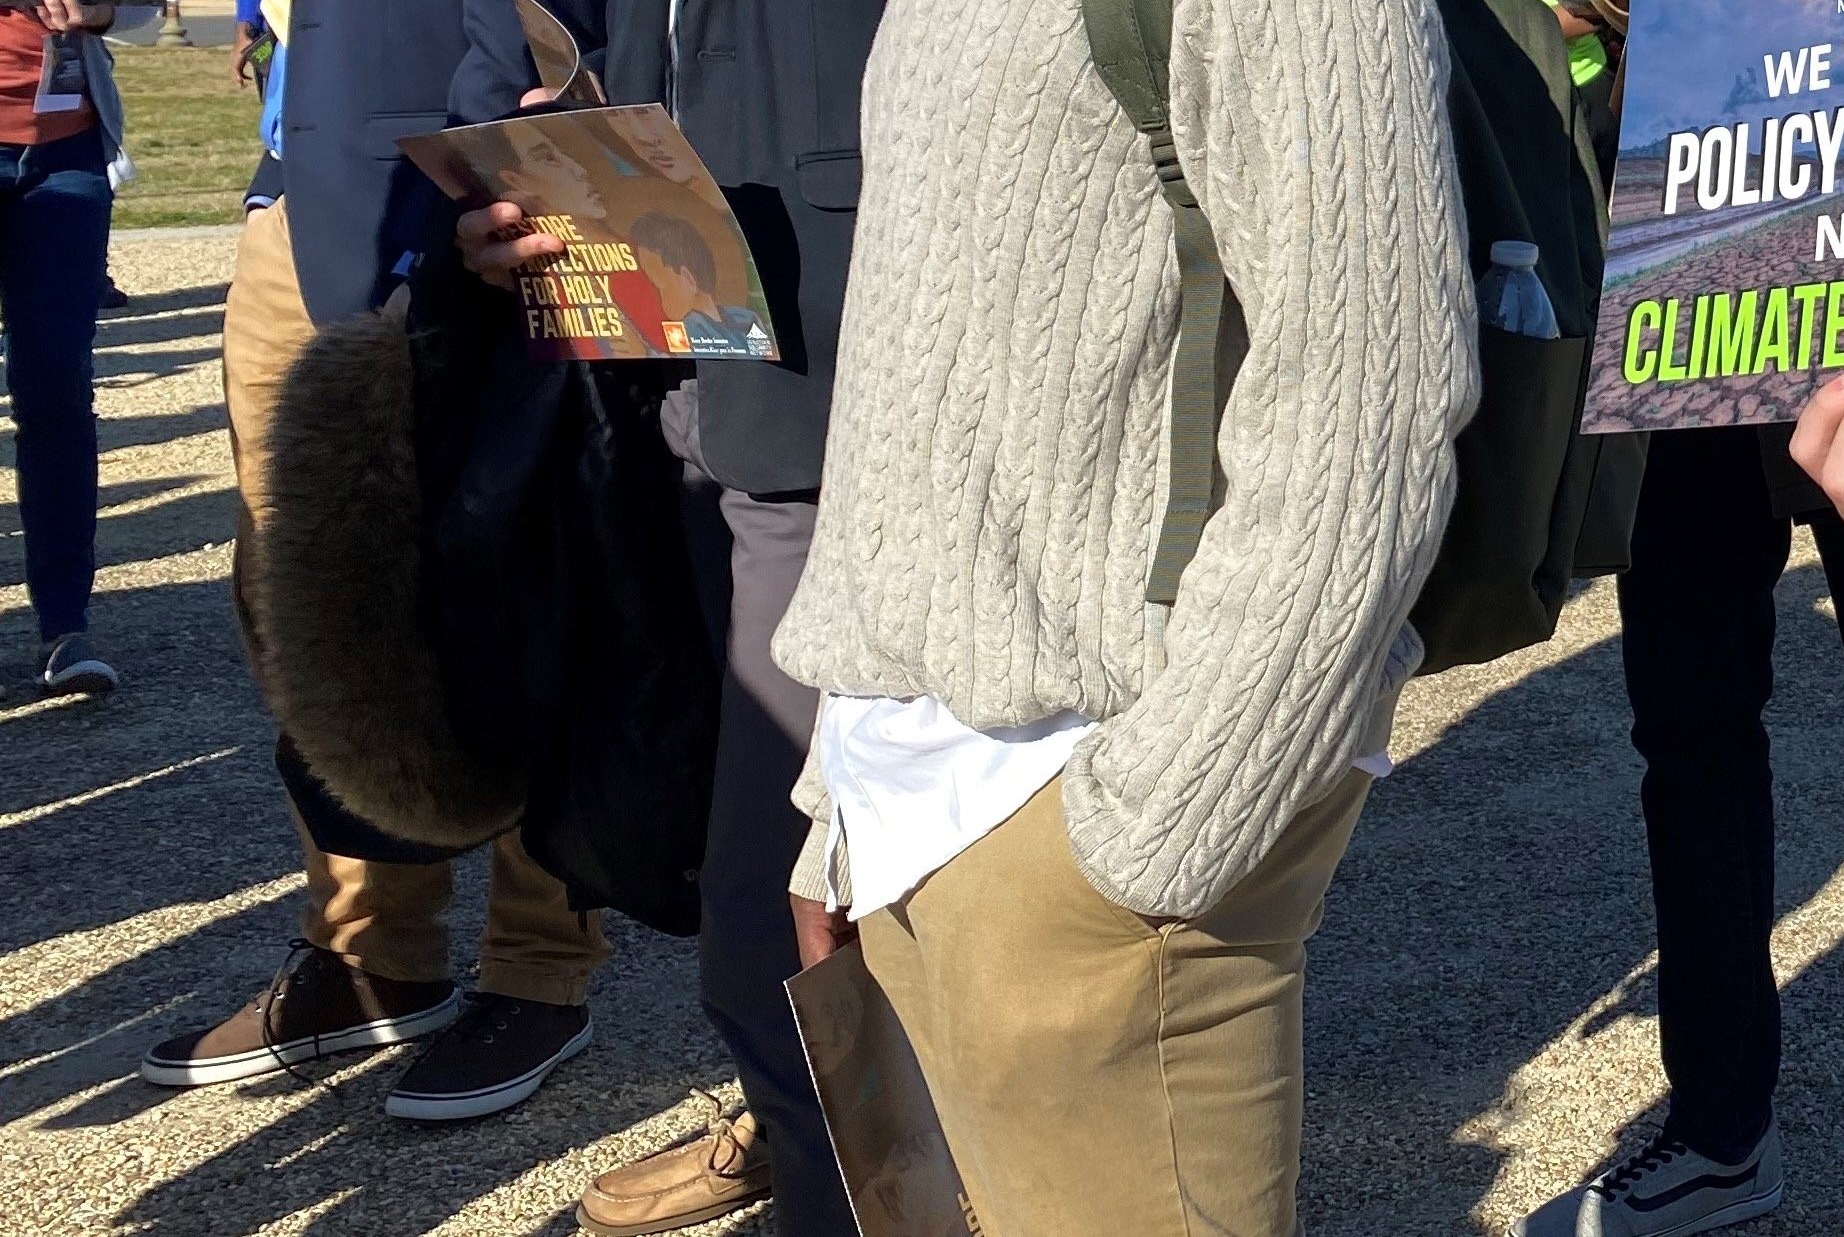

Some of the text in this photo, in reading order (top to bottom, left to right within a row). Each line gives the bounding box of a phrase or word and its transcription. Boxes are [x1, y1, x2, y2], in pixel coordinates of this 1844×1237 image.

[1763, 43, 1832, 98] WE
[519, 274, 613, 306] FOR HOLY
[526, 307, 624, 339] FAMILIES
